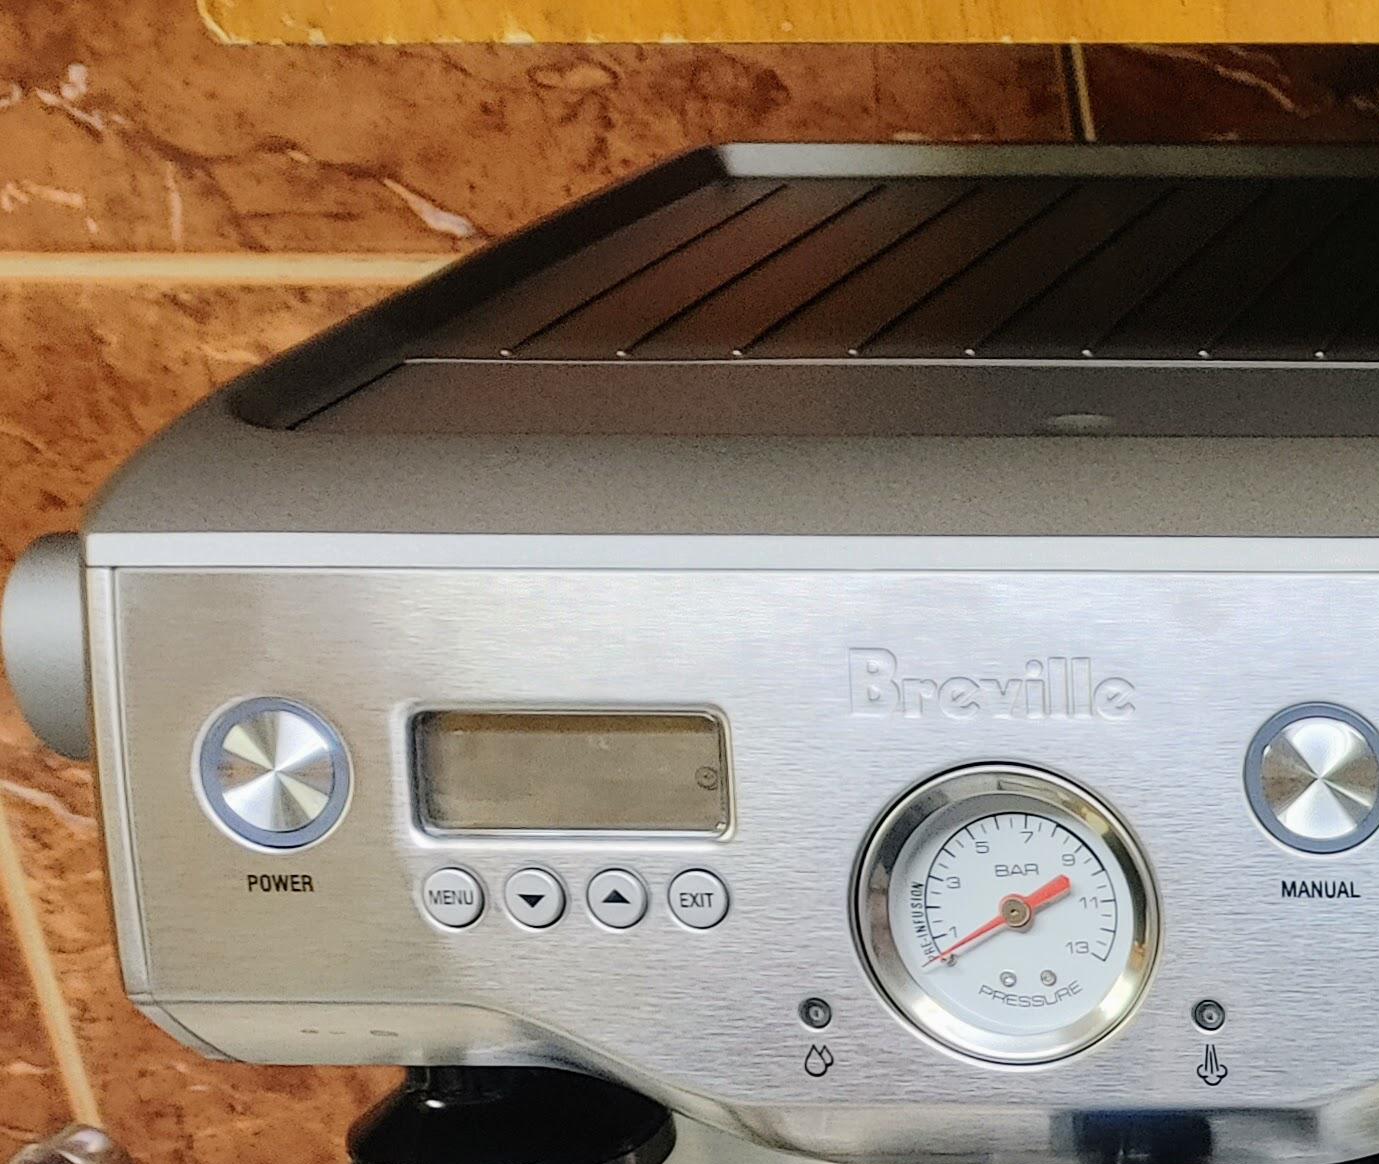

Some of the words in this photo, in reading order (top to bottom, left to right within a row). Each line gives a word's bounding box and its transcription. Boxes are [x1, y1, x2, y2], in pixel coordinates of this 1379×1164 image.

[847, 646, 1137, 721] Breville
[1020, 831, 1034, 843] 7
[975, 841, 990, 854] 5
[1062, 853, 1076, 866] 9
[994, 864, 1039, 877] BAR
[247, 874, 315, 893] POWER
[946, 876, 961, 889] 3
[1281, 879, 1361, 899] MANUAL
[428, 889, 475, 906] MENU
[679, 892, 715, 909] EXIT
[1080, 896, 1099, 909] 11
[1065, 941, 1090, 955] 13
[978, 979, 1084, 1008] PRESSURE
